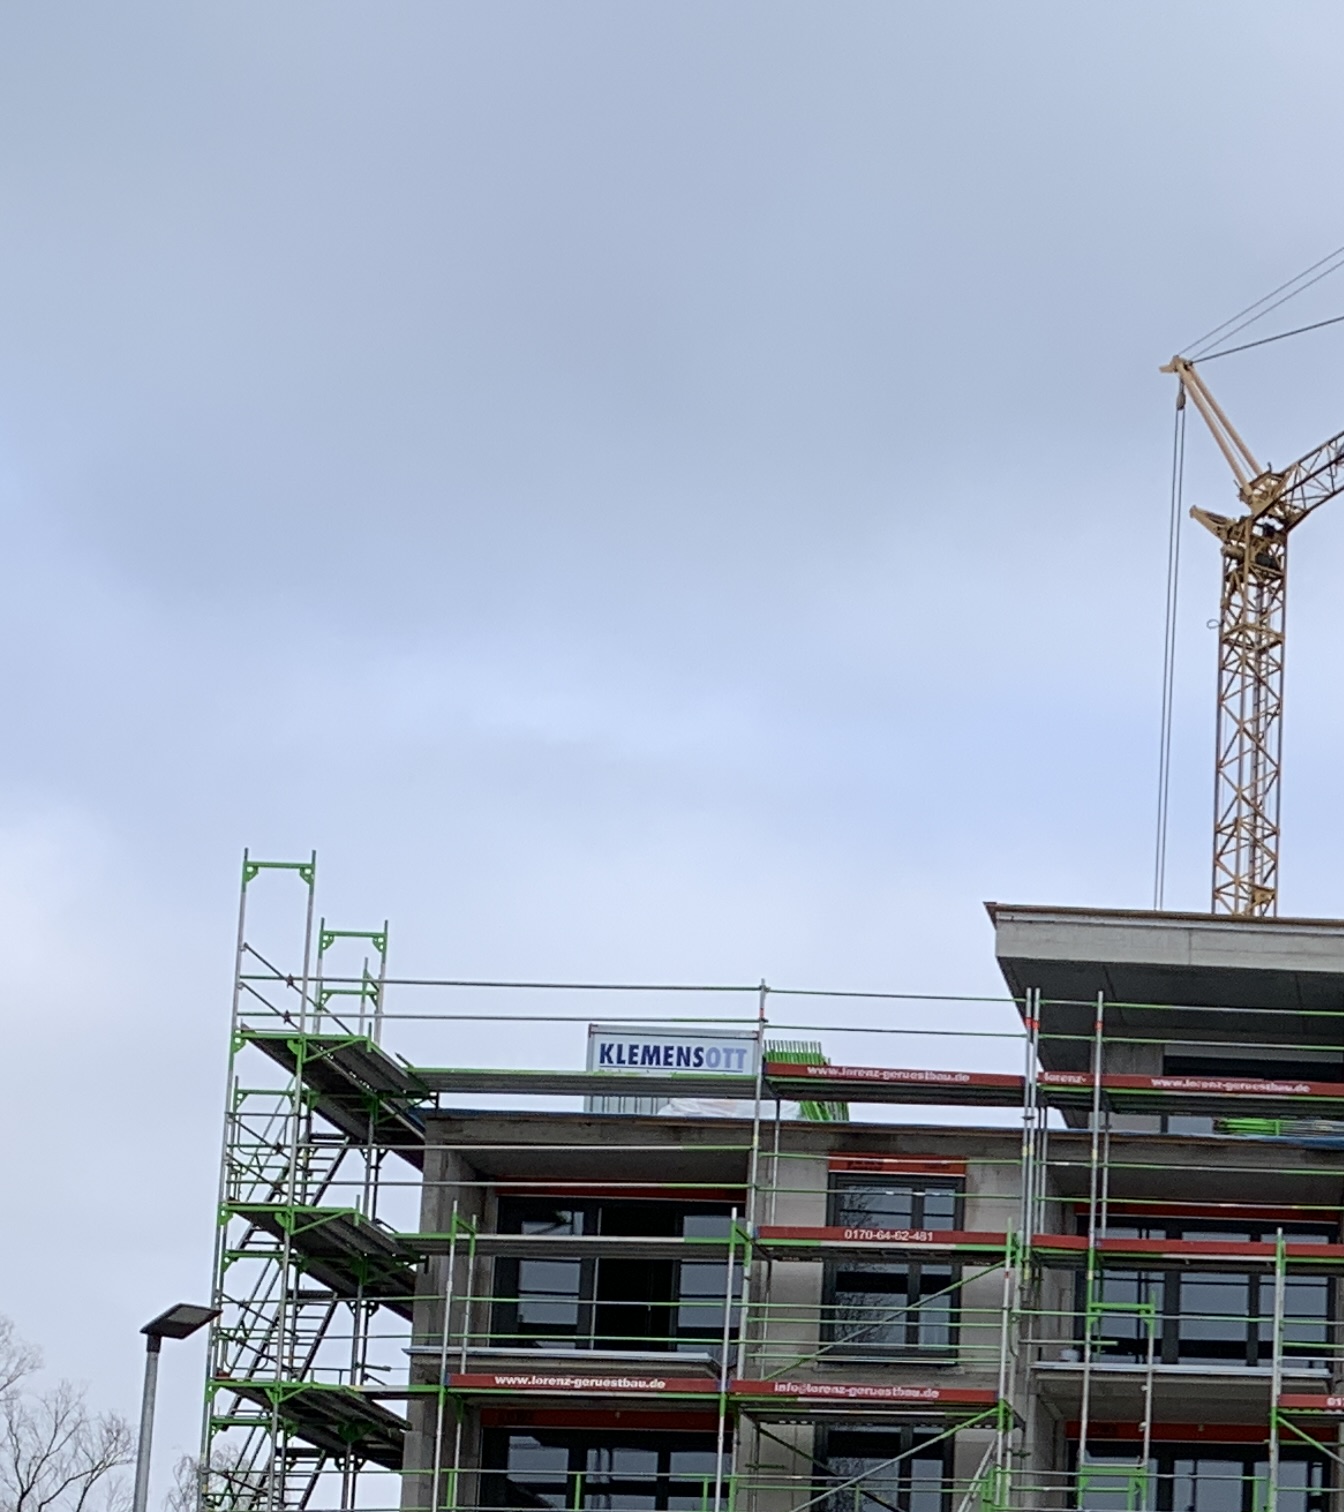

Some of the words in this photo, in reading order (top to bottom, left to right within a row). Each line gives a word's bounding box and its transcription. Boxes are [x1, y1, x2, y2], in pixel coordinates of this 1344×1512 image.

[599, 1042, 747, 1070] KLEMENSOTT
[807, 1065, 970, 1083] www.lorenz-geruestbau.de
[1152, 1077, 1310, 1094] www.lorenz-geruestbau.de
[844, 1229, 933, 1243] 0170-64-62-481
[495, 1374, 665, 1391] www.lorenz-geruestbau.de
